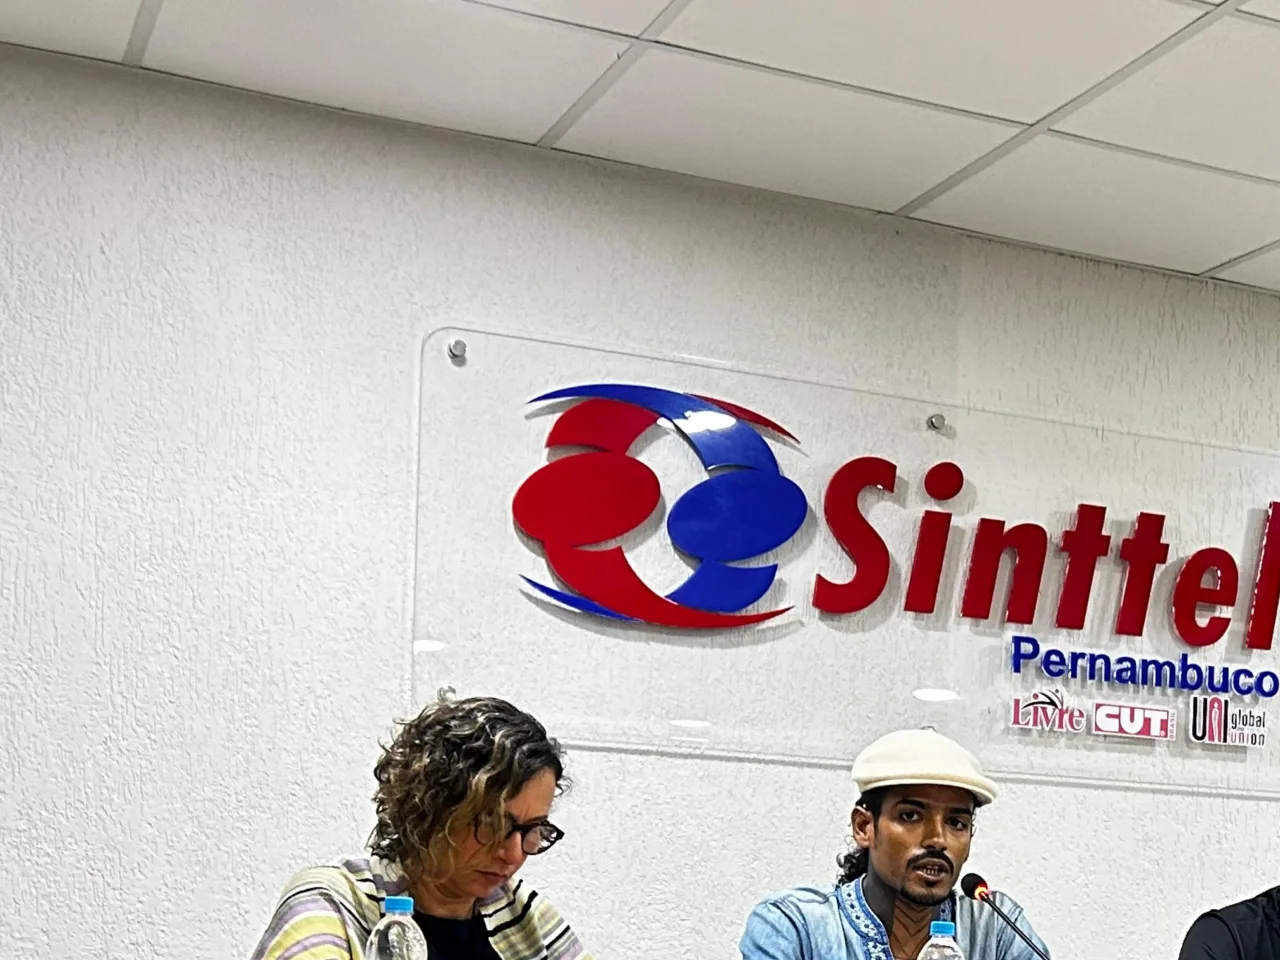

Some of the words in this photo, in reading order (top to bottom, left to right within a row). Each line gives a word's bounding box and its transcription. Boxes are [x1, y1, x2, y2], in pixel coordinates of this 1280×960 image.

[1011, 636, 1280, 698] Pernambuco
[1012, 692, 1085, 732] Livre
[1095, 705, 1168, 737] CUT
[1231, 709, 1266, 729] global
[1230, 732, 1265, 746] union
